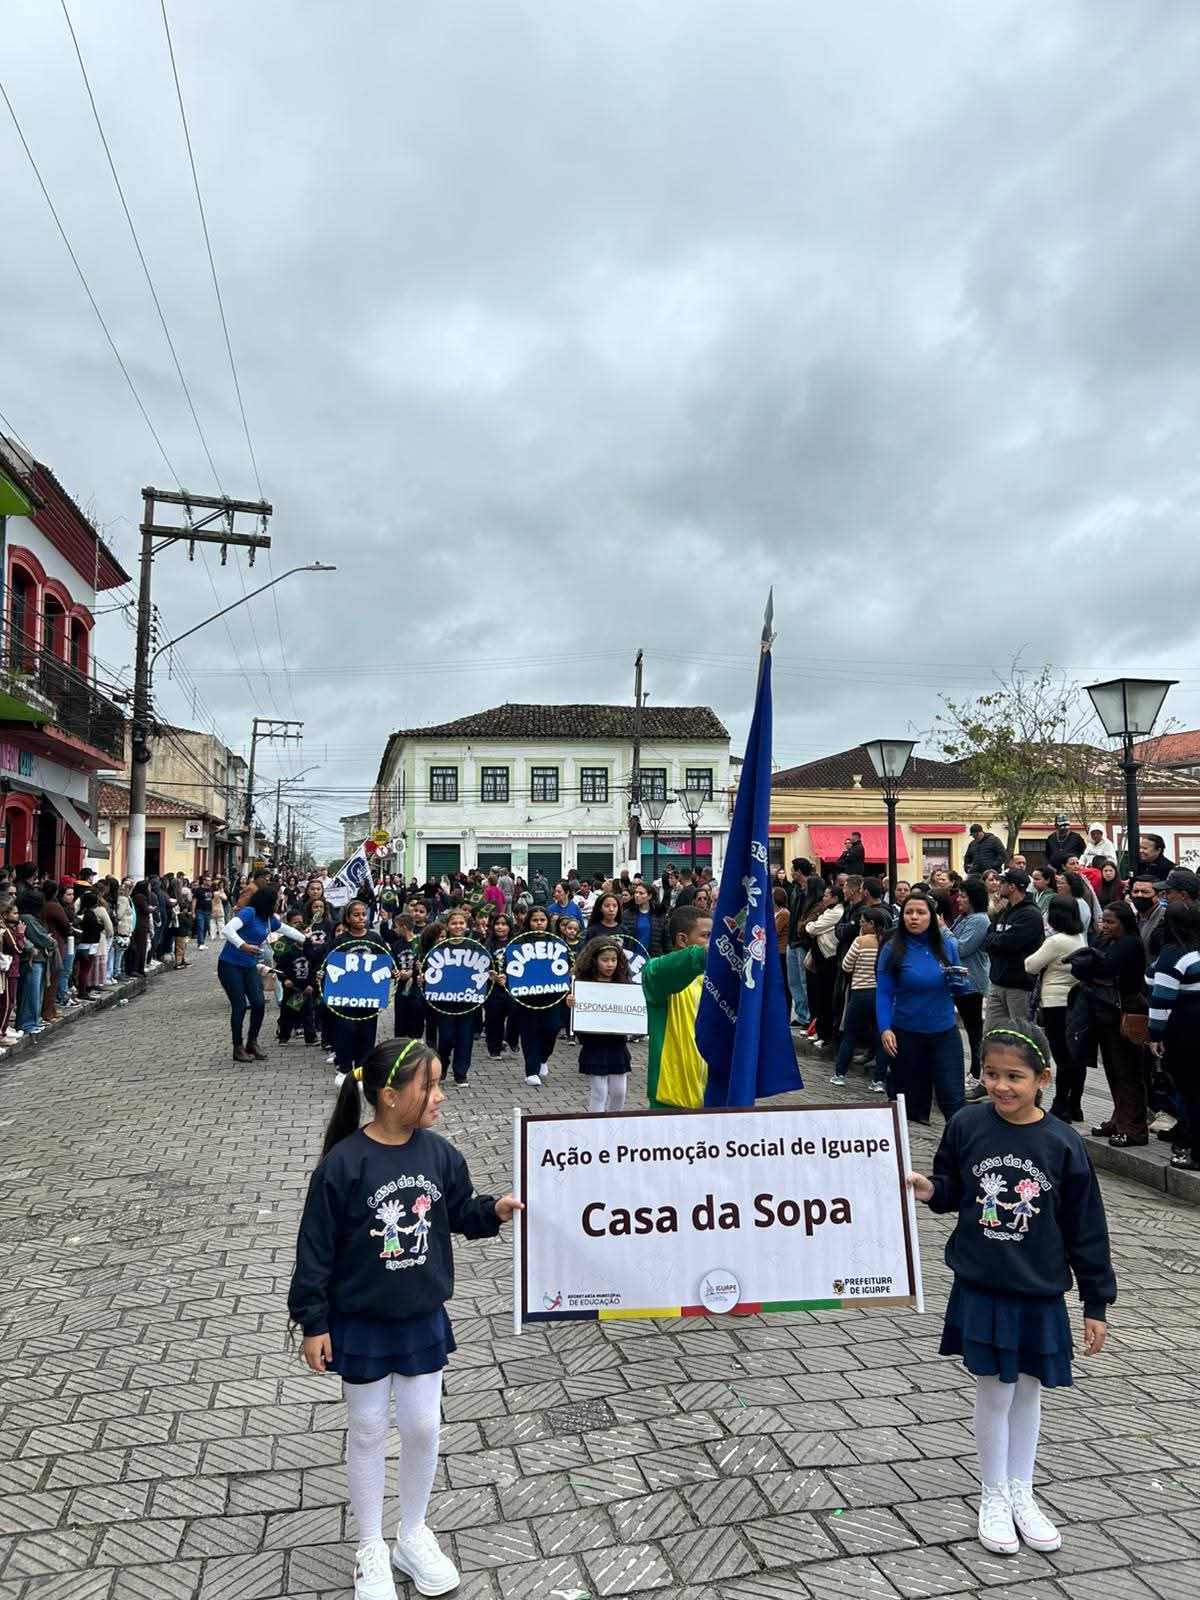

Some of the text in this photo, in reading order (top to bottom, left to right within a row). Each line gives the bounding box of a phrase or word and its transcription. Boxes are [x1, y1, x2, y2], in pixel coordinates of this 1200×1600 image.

[326, 953, 391, 984] ARTE
[424, 947, 490, 989] CULTURA
[506, 941, 569, 978] DIREITO
[327, 995, 380, 1008] ESPORTE
[425, 988, 485, 1004] TRADIÇÕES
[510, 982, 570, 997] CIDADANIA
[703, 974, 738, 1024] OCIAL CASA
[574, 1002, 647, 1015] RESPONSABILIDADE
[541, 1137, 890, 1171] Ação e Promoção Social de Iguape
[972, 1153, 1053, 1192] Casa da Sopa
[367, 1174, 442, 1208] Casa da Sopa
[581, 1193, 852, 1237] Casa da Sopa
[844, 1276, 893, 1286] PREFEITURA
[849, 1285, 891, 1295] DE IGUAPE
[580, 1297, 621, 1306] EDUCAÇÃO
